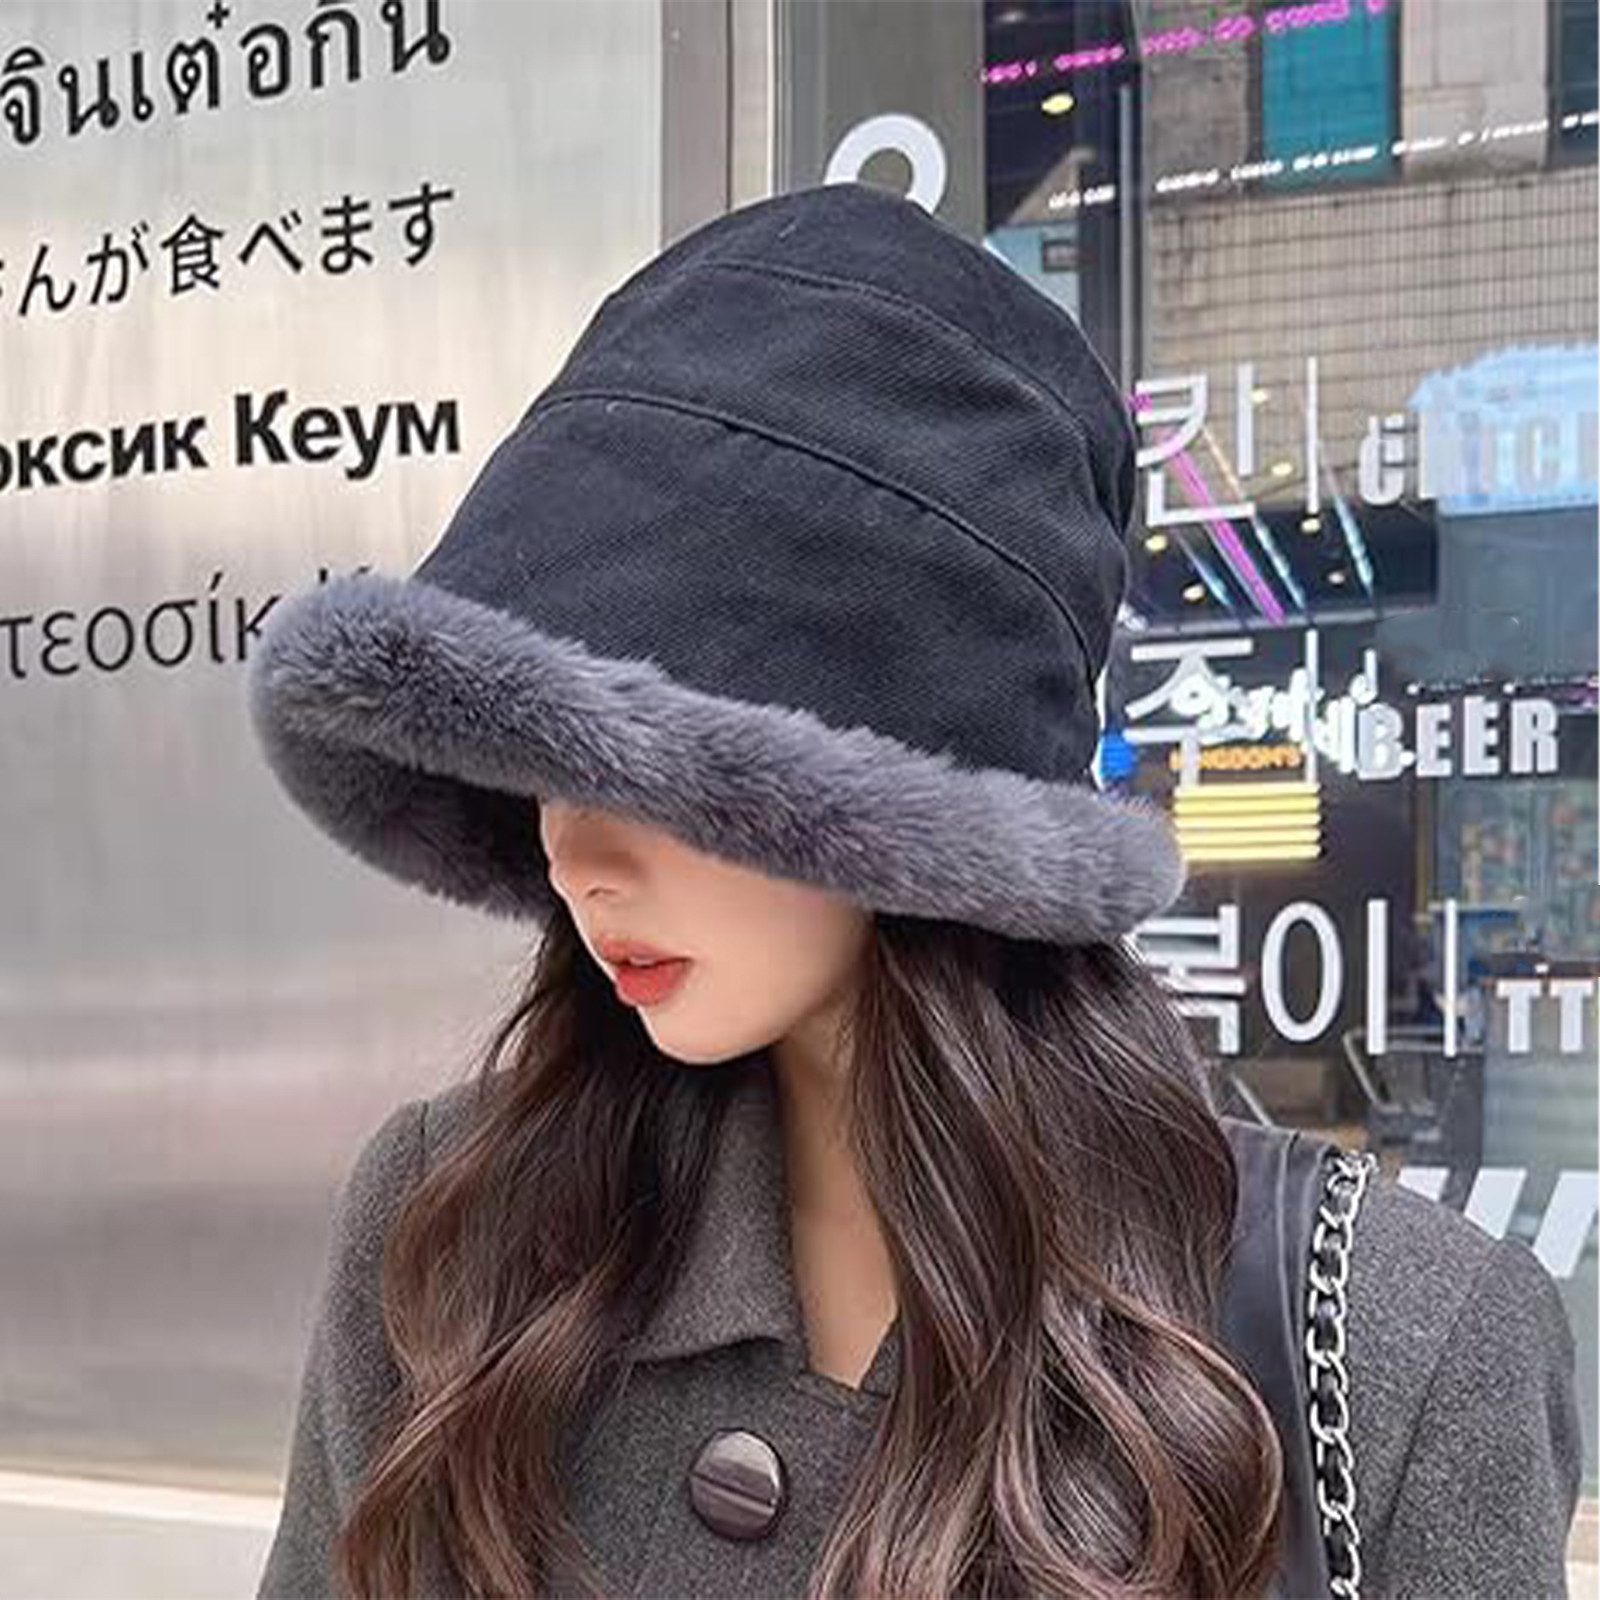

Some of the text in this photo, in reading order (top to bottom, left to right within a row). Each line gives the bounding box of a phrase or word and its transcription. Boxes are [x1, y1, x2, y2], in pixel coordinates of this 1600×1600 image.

[0, 183, 454, 316] んが食べます
[0, 390, 460, 491] ксик Кеум
[1136, 363, 1255, 527] 킨
[1357, 695, 1559, 780] BEER
